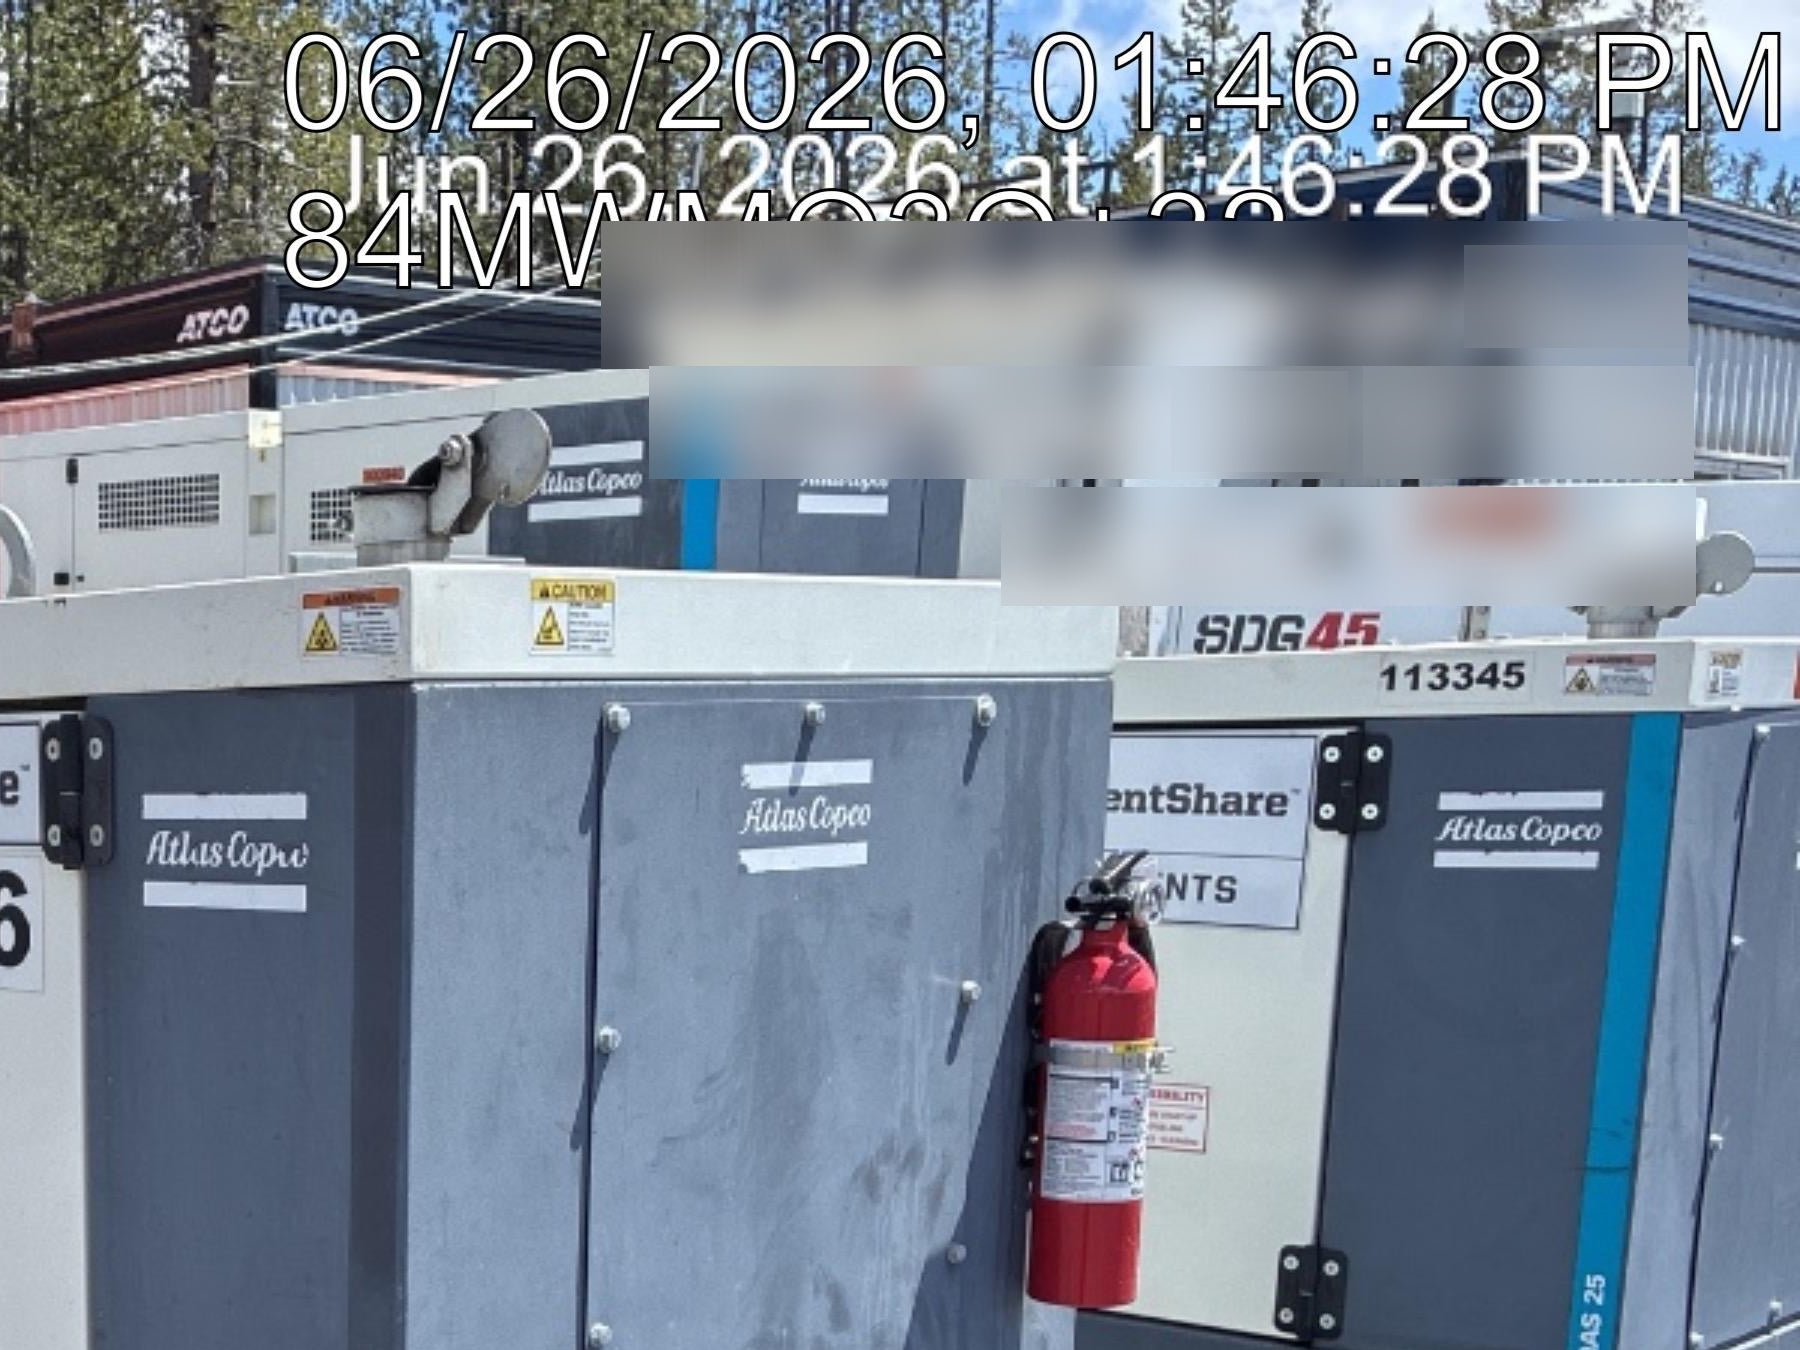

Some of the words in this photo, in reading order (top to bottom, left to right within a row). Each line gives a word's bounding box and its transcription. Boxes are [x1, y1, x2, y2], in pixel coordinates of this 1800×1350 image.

[176, 304, 250, 344] ATCO
[284, 302, 360, 337] ATCO
[1193, 611, 1381, 655] SDG45
[1379, 660, 1526, 692] 113345
[737, 797, 808, 835] Atlas
[808, 794, 872, 838] Copco
[1434, 814, 1519, 841] Atlas
[1519, 814, 1603, 847] Copco
[1582, 1273, 1607, 1307] 25
